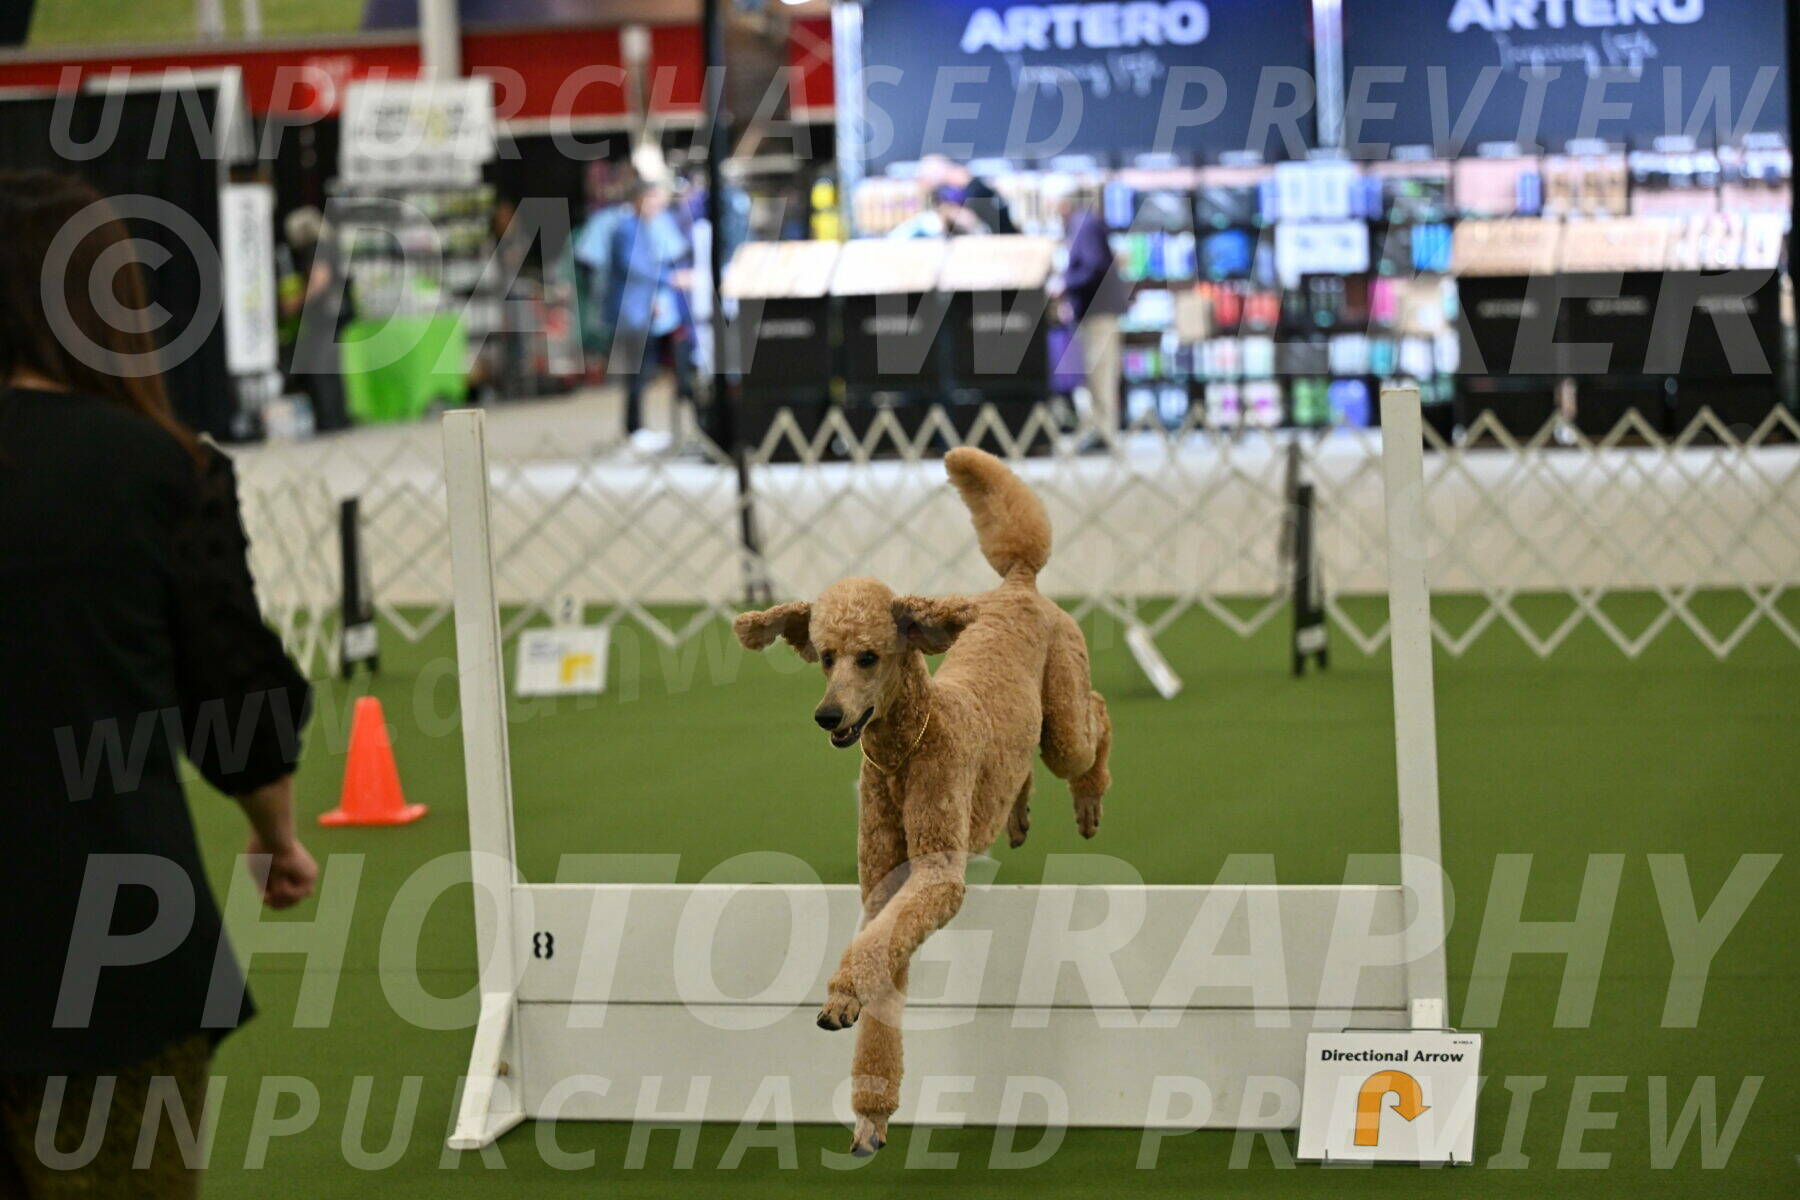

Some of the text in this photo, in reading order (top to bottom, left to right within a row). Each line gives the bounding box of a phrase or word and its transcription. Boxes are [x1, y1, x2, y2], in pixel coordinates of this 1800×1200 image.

[960, 0, 1210, 54] ARTERO
[533, 931, 553, 960] 8
[1321, 1049, 1464, 1062] Directional Arrow
